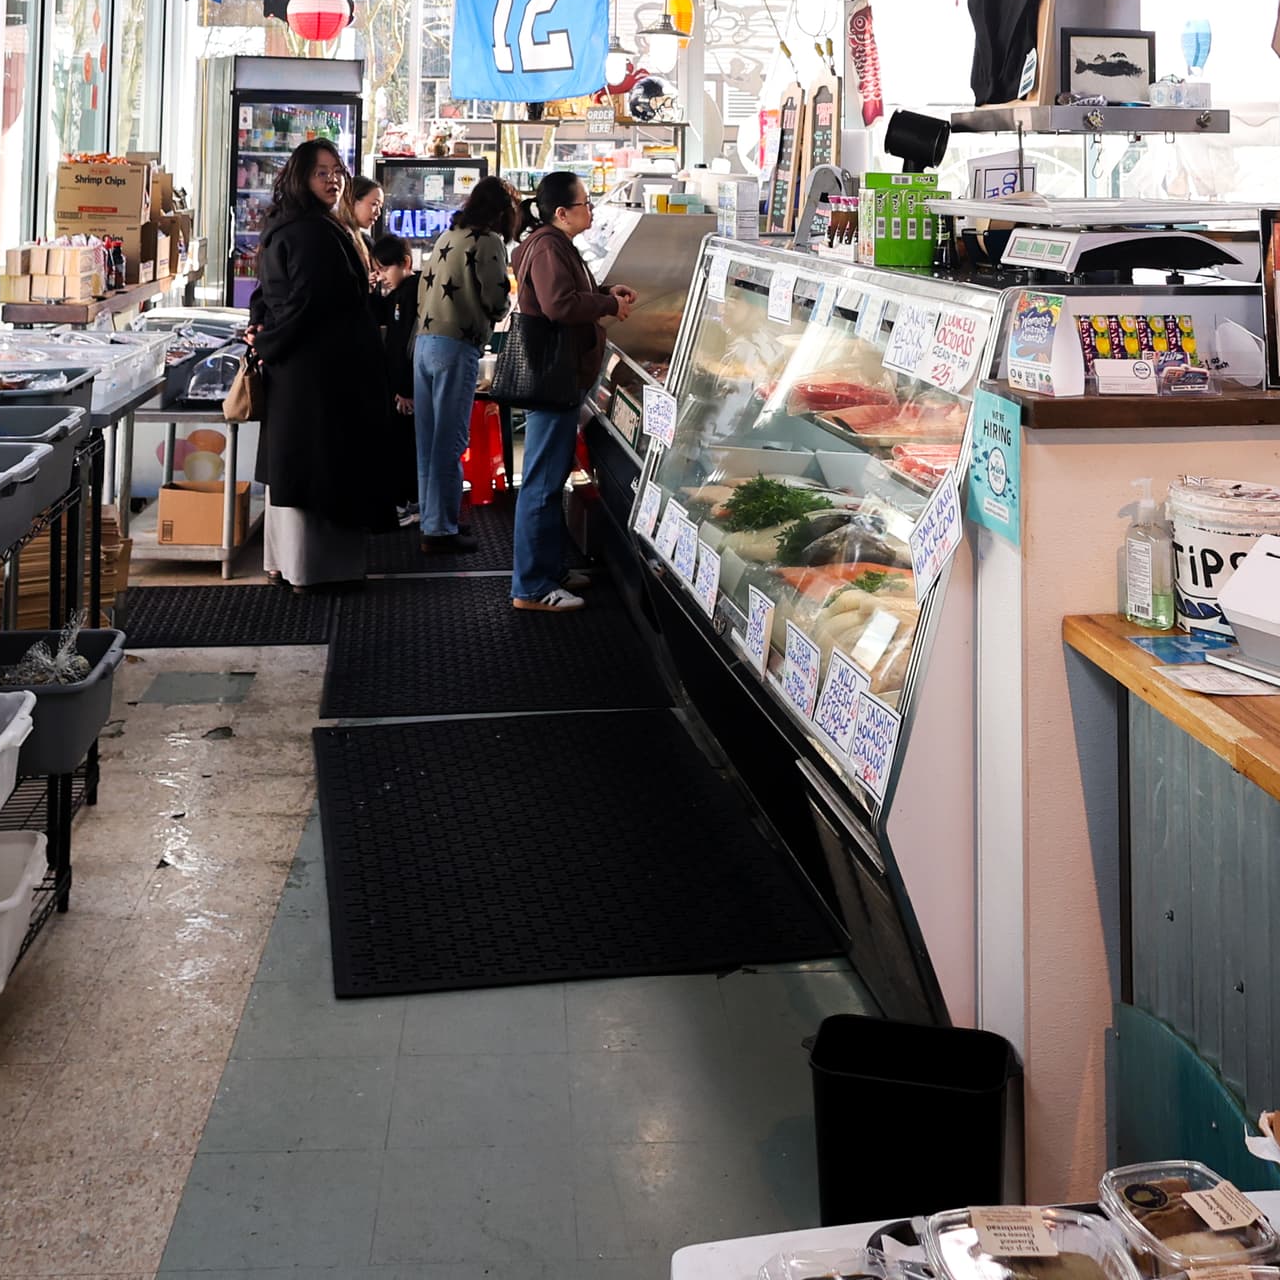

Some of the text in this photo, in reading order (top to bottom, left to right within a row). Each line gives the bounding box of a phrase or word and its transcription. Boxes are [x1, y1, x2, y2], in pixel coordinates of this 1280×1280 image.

[74, 174, 127, 187] Shrimp Chips
[982, 419, 1012, 448] HIRING
